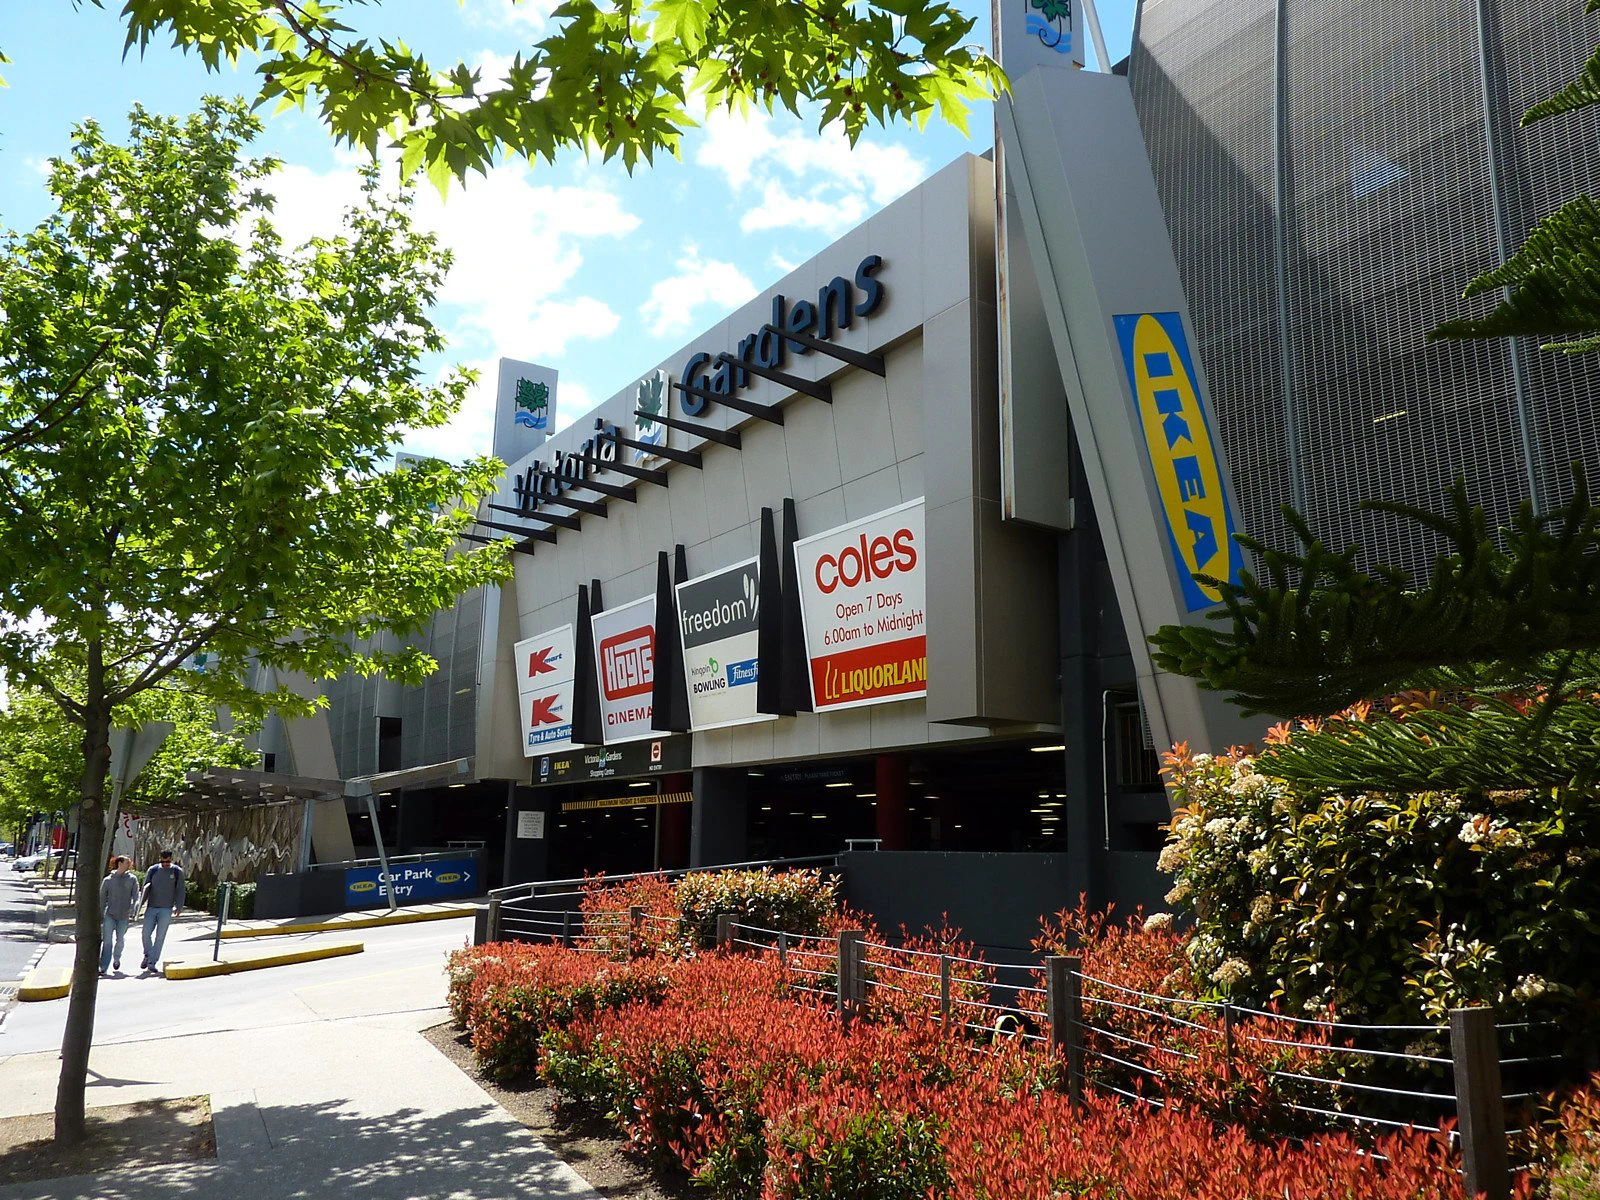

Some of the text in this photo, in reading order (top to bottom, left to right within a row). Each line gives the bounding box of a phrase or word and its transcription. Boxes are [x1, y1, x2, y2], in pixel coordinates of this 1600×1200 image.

[515, 255, 884, 512] Victoria Gardens
[1143, 352, 1220, 571] IKEA
[815, 528, 917, 594] coles
[836, 592, 903, 620] Open 7 Days
[682, 600, 747, 635] freedom
[824, 610, 924, 646] 6.00am to Midnight
[693, 678, 726, 693] BOWLING
[530, 733, 540, 743] Tyre
[545, 730, 557, 740] Auto
[557, 726, 572, 738] Servic
[554, 760, 570, 770] IKEA
[584, 752, 622, 764] Victoria Gardens
[589, 769, 604, 778] Shopping
[378, 868, 432, 883] Car Park
[379, 885, 413, 896] Etry
